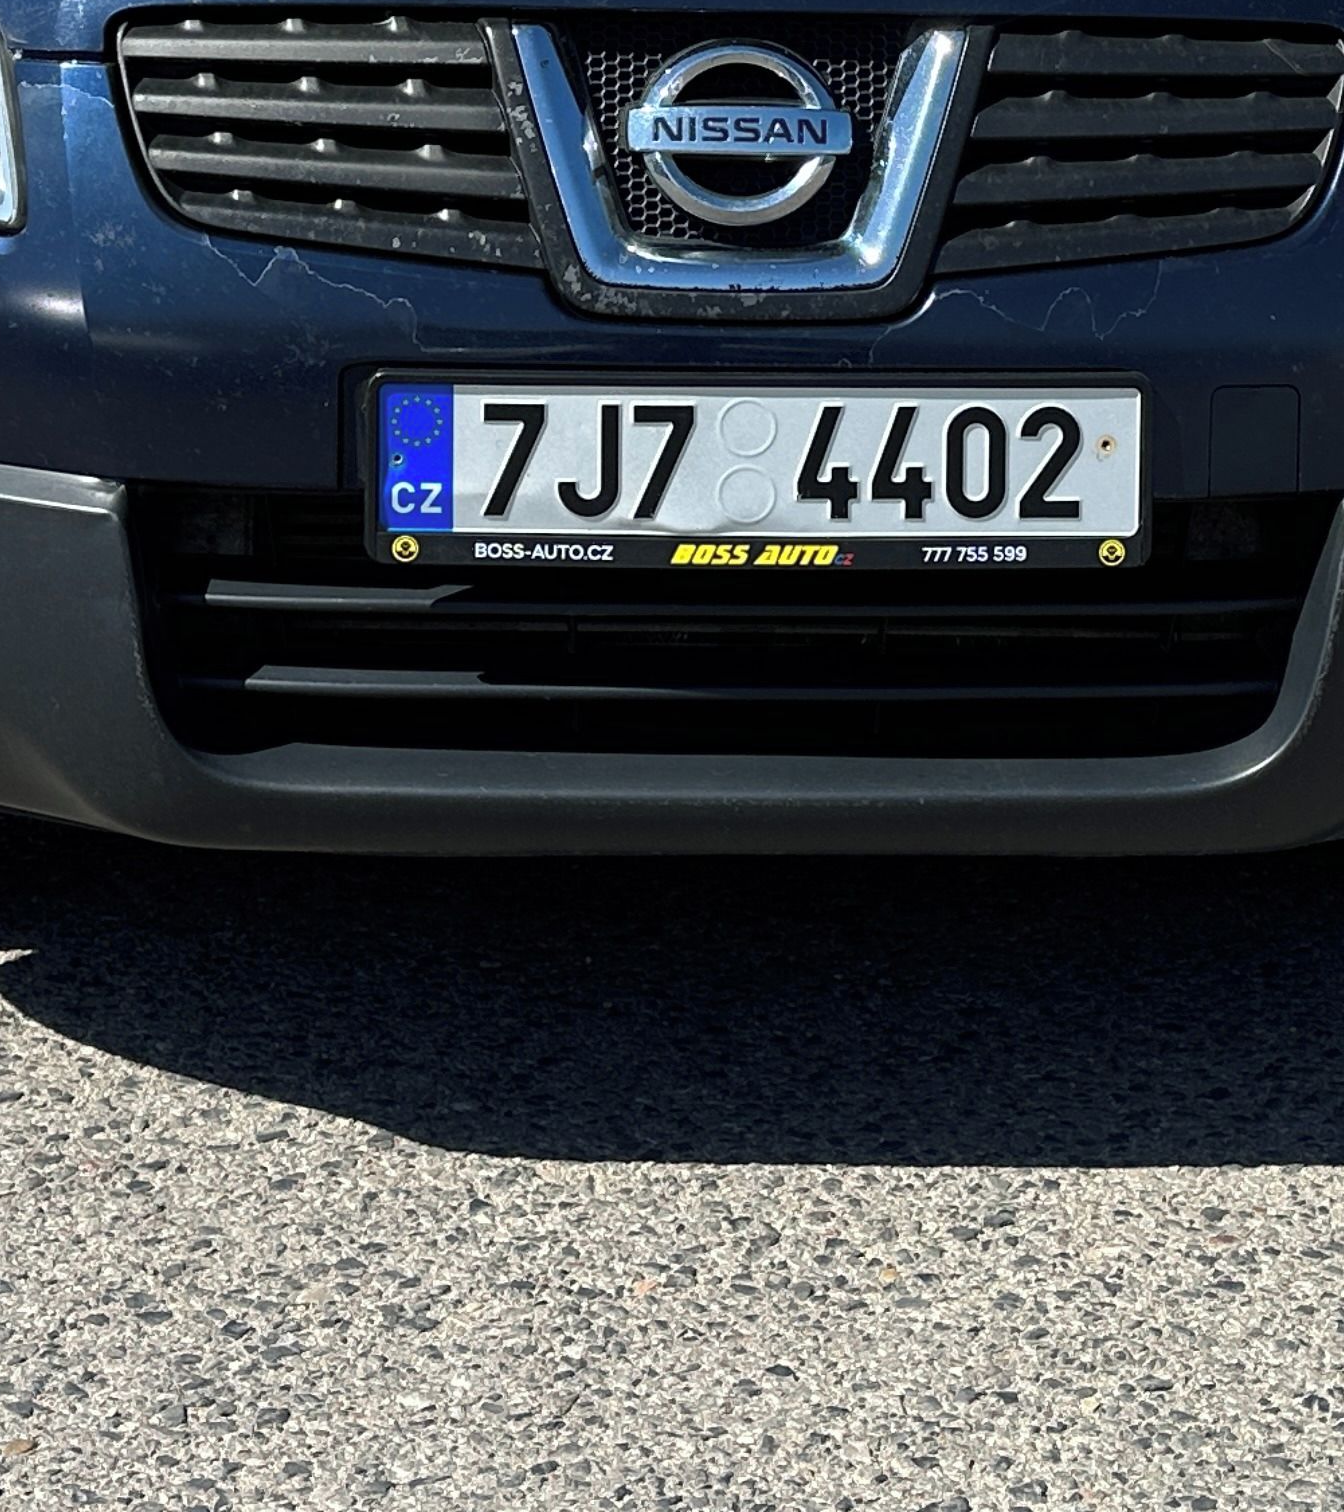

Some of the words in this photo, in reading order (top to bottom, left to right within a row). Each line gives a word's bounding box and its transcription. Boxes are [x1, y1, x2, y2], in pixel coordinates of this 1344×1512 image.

[651, 116, 828, 145] NISSAN
[481, 403, 697, 519] 7J7
[796, 405, 1083, 520] 4402
[390, 481, 443, 515] CZ
[474, 543, 614, 561] BOSS-AUTO.CZ
[670, 544, 750, 565] BOSS
[753, 544, 839, 565] AUTO
[921, 546, 952, 562] 777
[955, 546, 989, 562] 755
[992, 546, 1027, 562] 599
